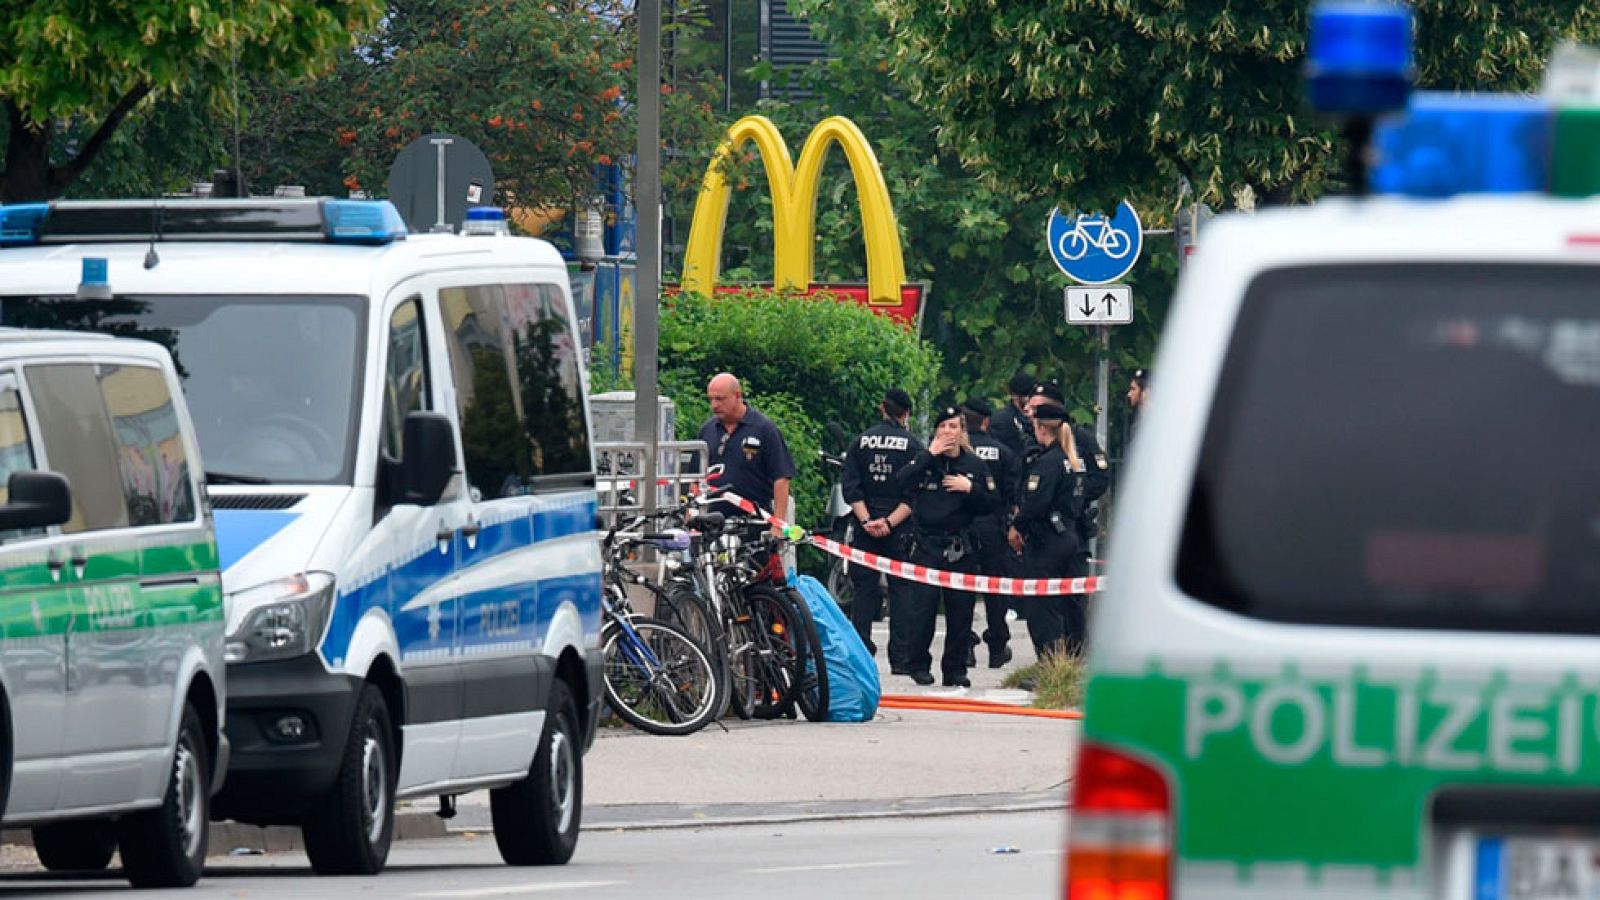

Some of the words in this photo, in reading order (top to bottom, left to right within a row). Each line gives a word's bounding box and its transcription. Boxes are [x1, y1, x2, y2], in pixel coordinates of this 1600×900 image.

[681, 115, 906, 305] M
[861, 435, 908, 451] POLIZEI
[874, 454, 887, 464] BY
[975, 446, 999, 460] IZEI
[83, 586, 134, 626] POLIZEI
[480, 600, 519, 637] POLIZEI
[1184, 682, 1580, 774] POLIZEI
